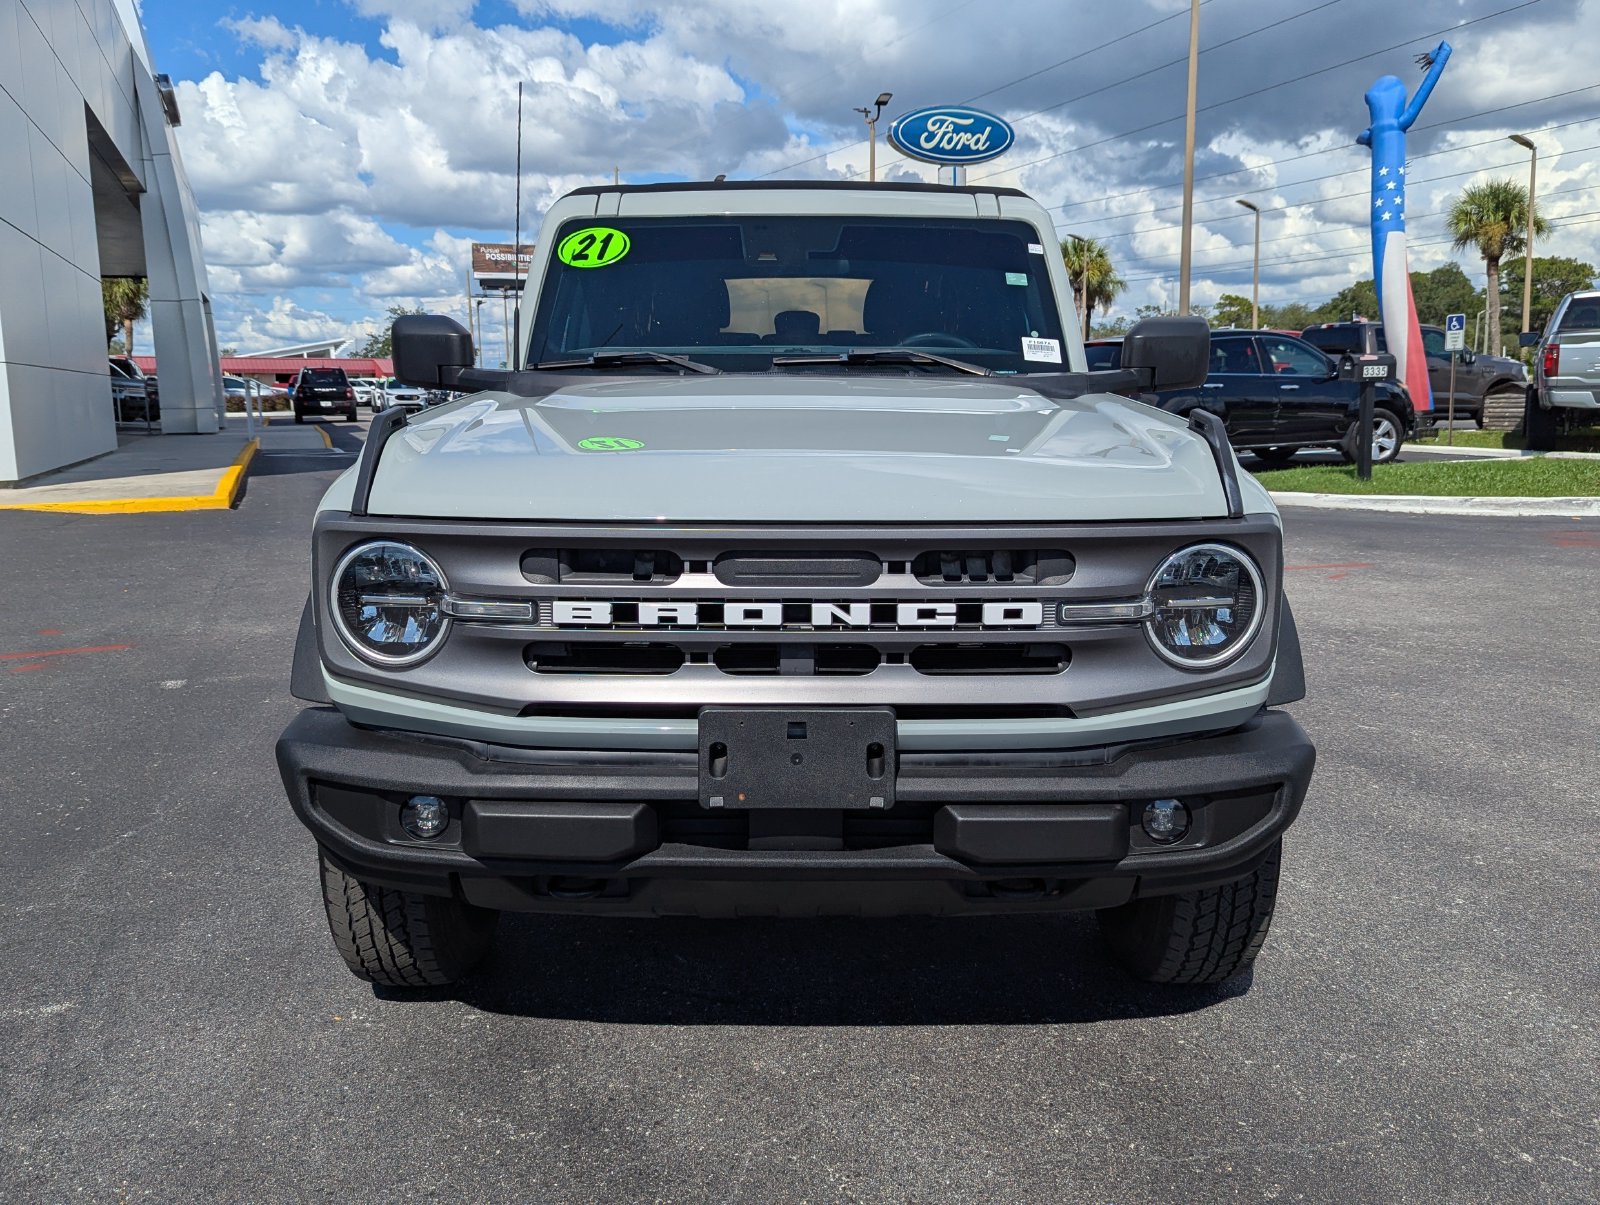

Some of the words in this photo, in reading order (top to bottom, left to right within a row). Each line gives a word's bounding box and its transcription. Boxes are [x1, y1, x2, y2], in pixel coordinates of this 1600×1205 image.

[920, 115, 992, 150] Ford
[571, 233, 614, 261] 21
[1363, 366, 1387, 376] 3335
[552, 602, 1043, 625] BRONCO
